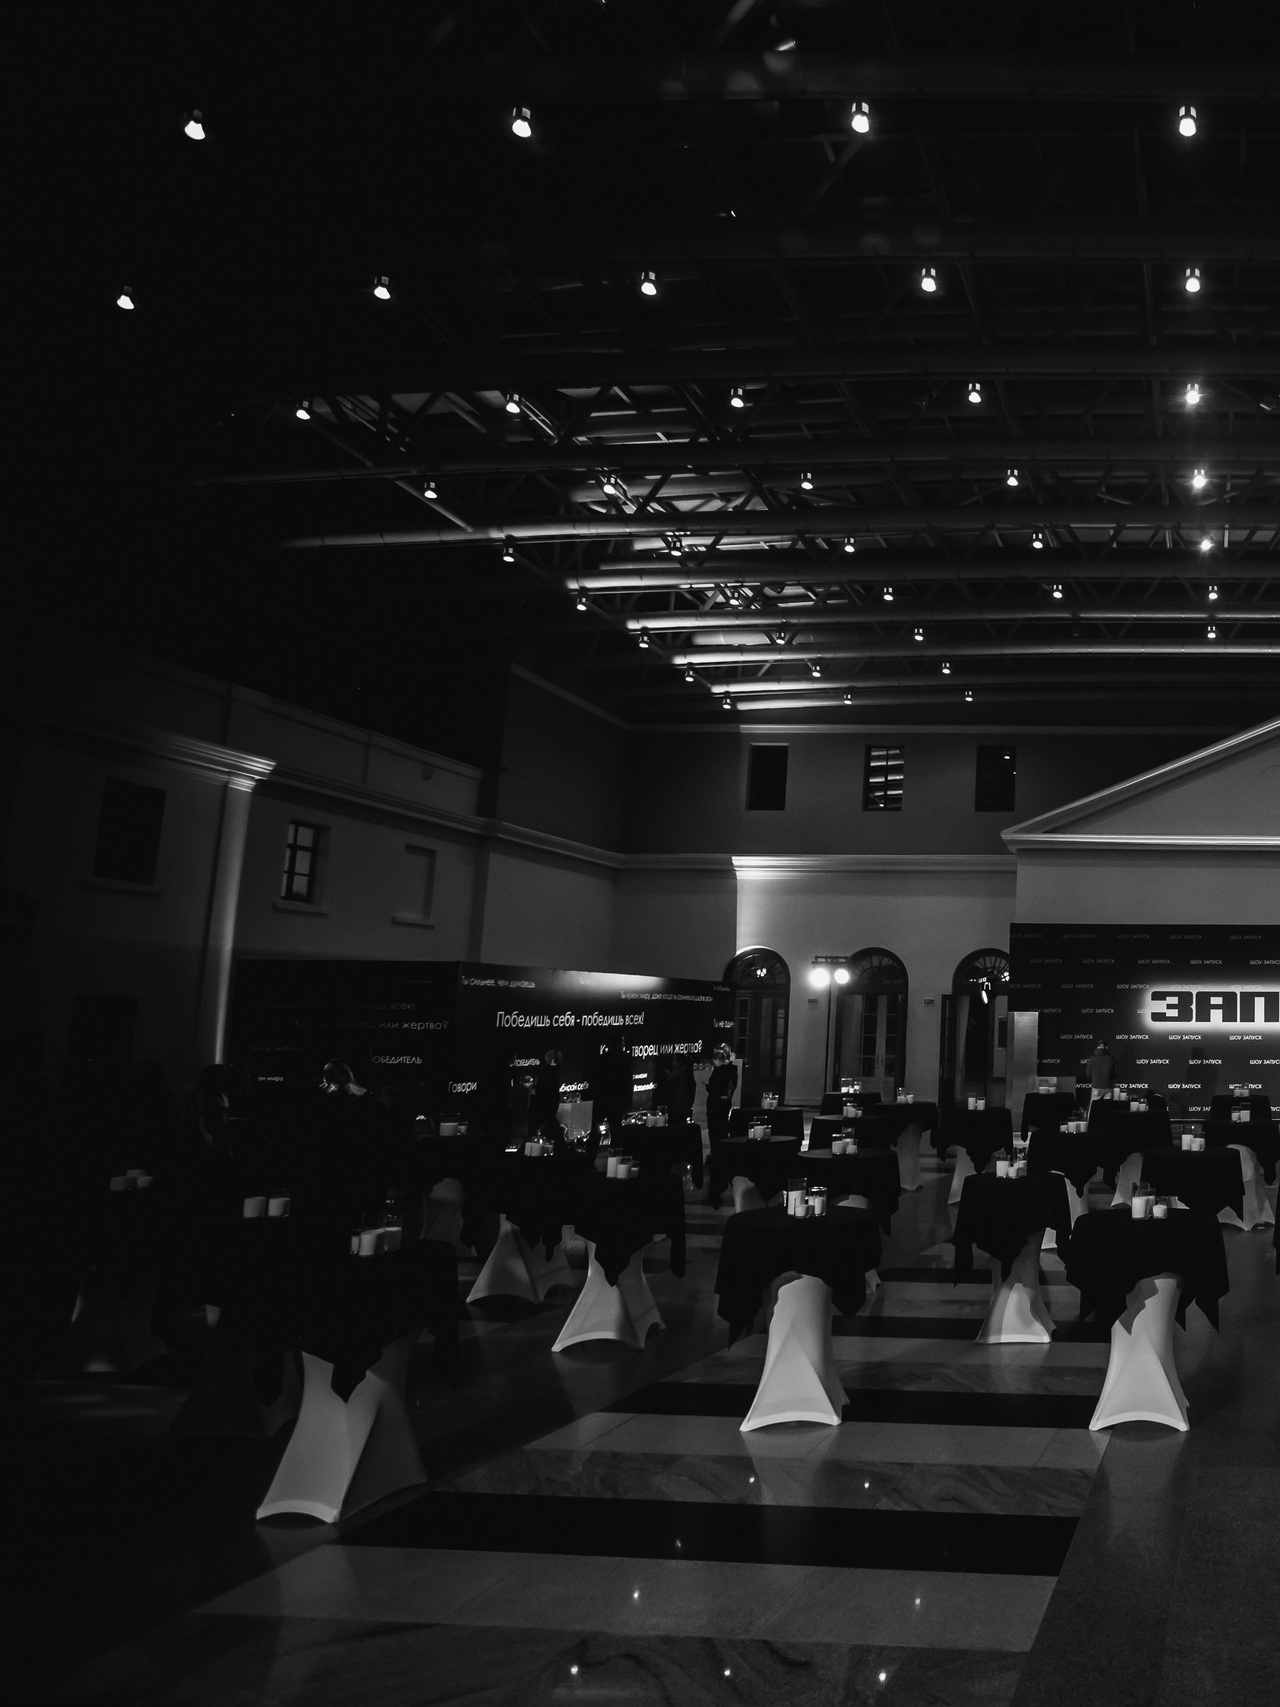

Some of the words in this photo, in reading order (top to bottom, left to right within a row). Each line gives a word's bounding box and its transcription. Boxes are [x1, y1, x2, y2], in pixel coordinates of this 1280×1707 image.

[401, 1020, 449, 1031] жертва?
[496, 1011, 551, 1028] Победишь
[552, 1011, 575, 1027] себя
[581, 1011, 624, 1026] победишь
[625, 1012, 644, 1025] всех!
[632, 1045, 659, 1060] творец
[660, 1044, 673, 1054] или
[674, 1040, 702, 1054] жертва?
[448, 1081, 477, 1094] Говори
